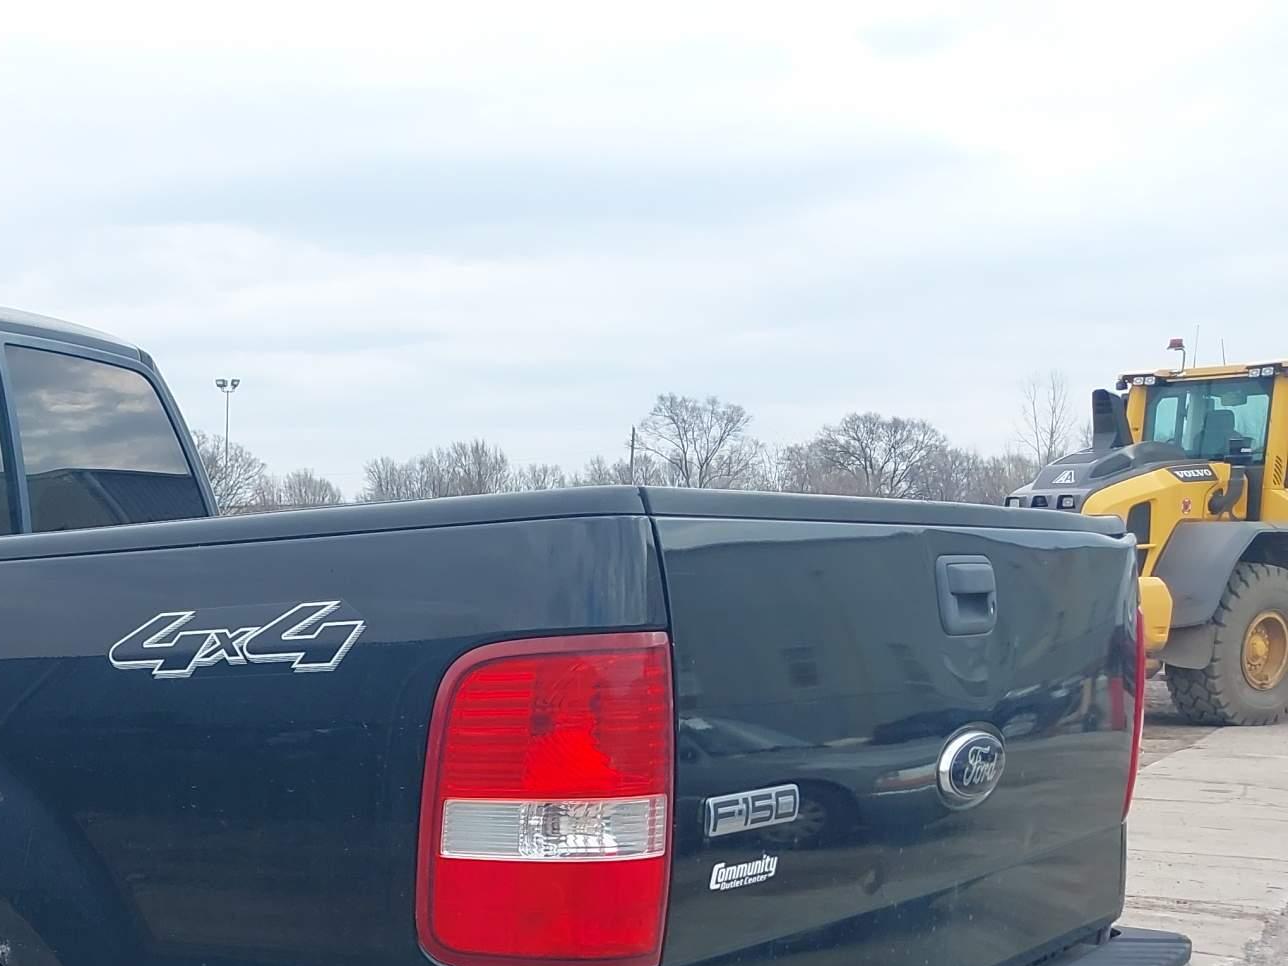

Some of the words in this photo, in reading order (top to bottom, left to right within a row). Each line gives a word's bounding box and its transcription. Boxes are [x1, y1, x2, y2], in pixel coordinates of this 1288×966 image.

[1173, 468, 1212, 478] VOLVO
[109, 600, 367, 679] 4x4
[962, 745, 998, 787] Ford
[709, 854, 779, 890] Community
[720, 879, 743, 890] Outlet
[744, 874, 768, 885] Center
